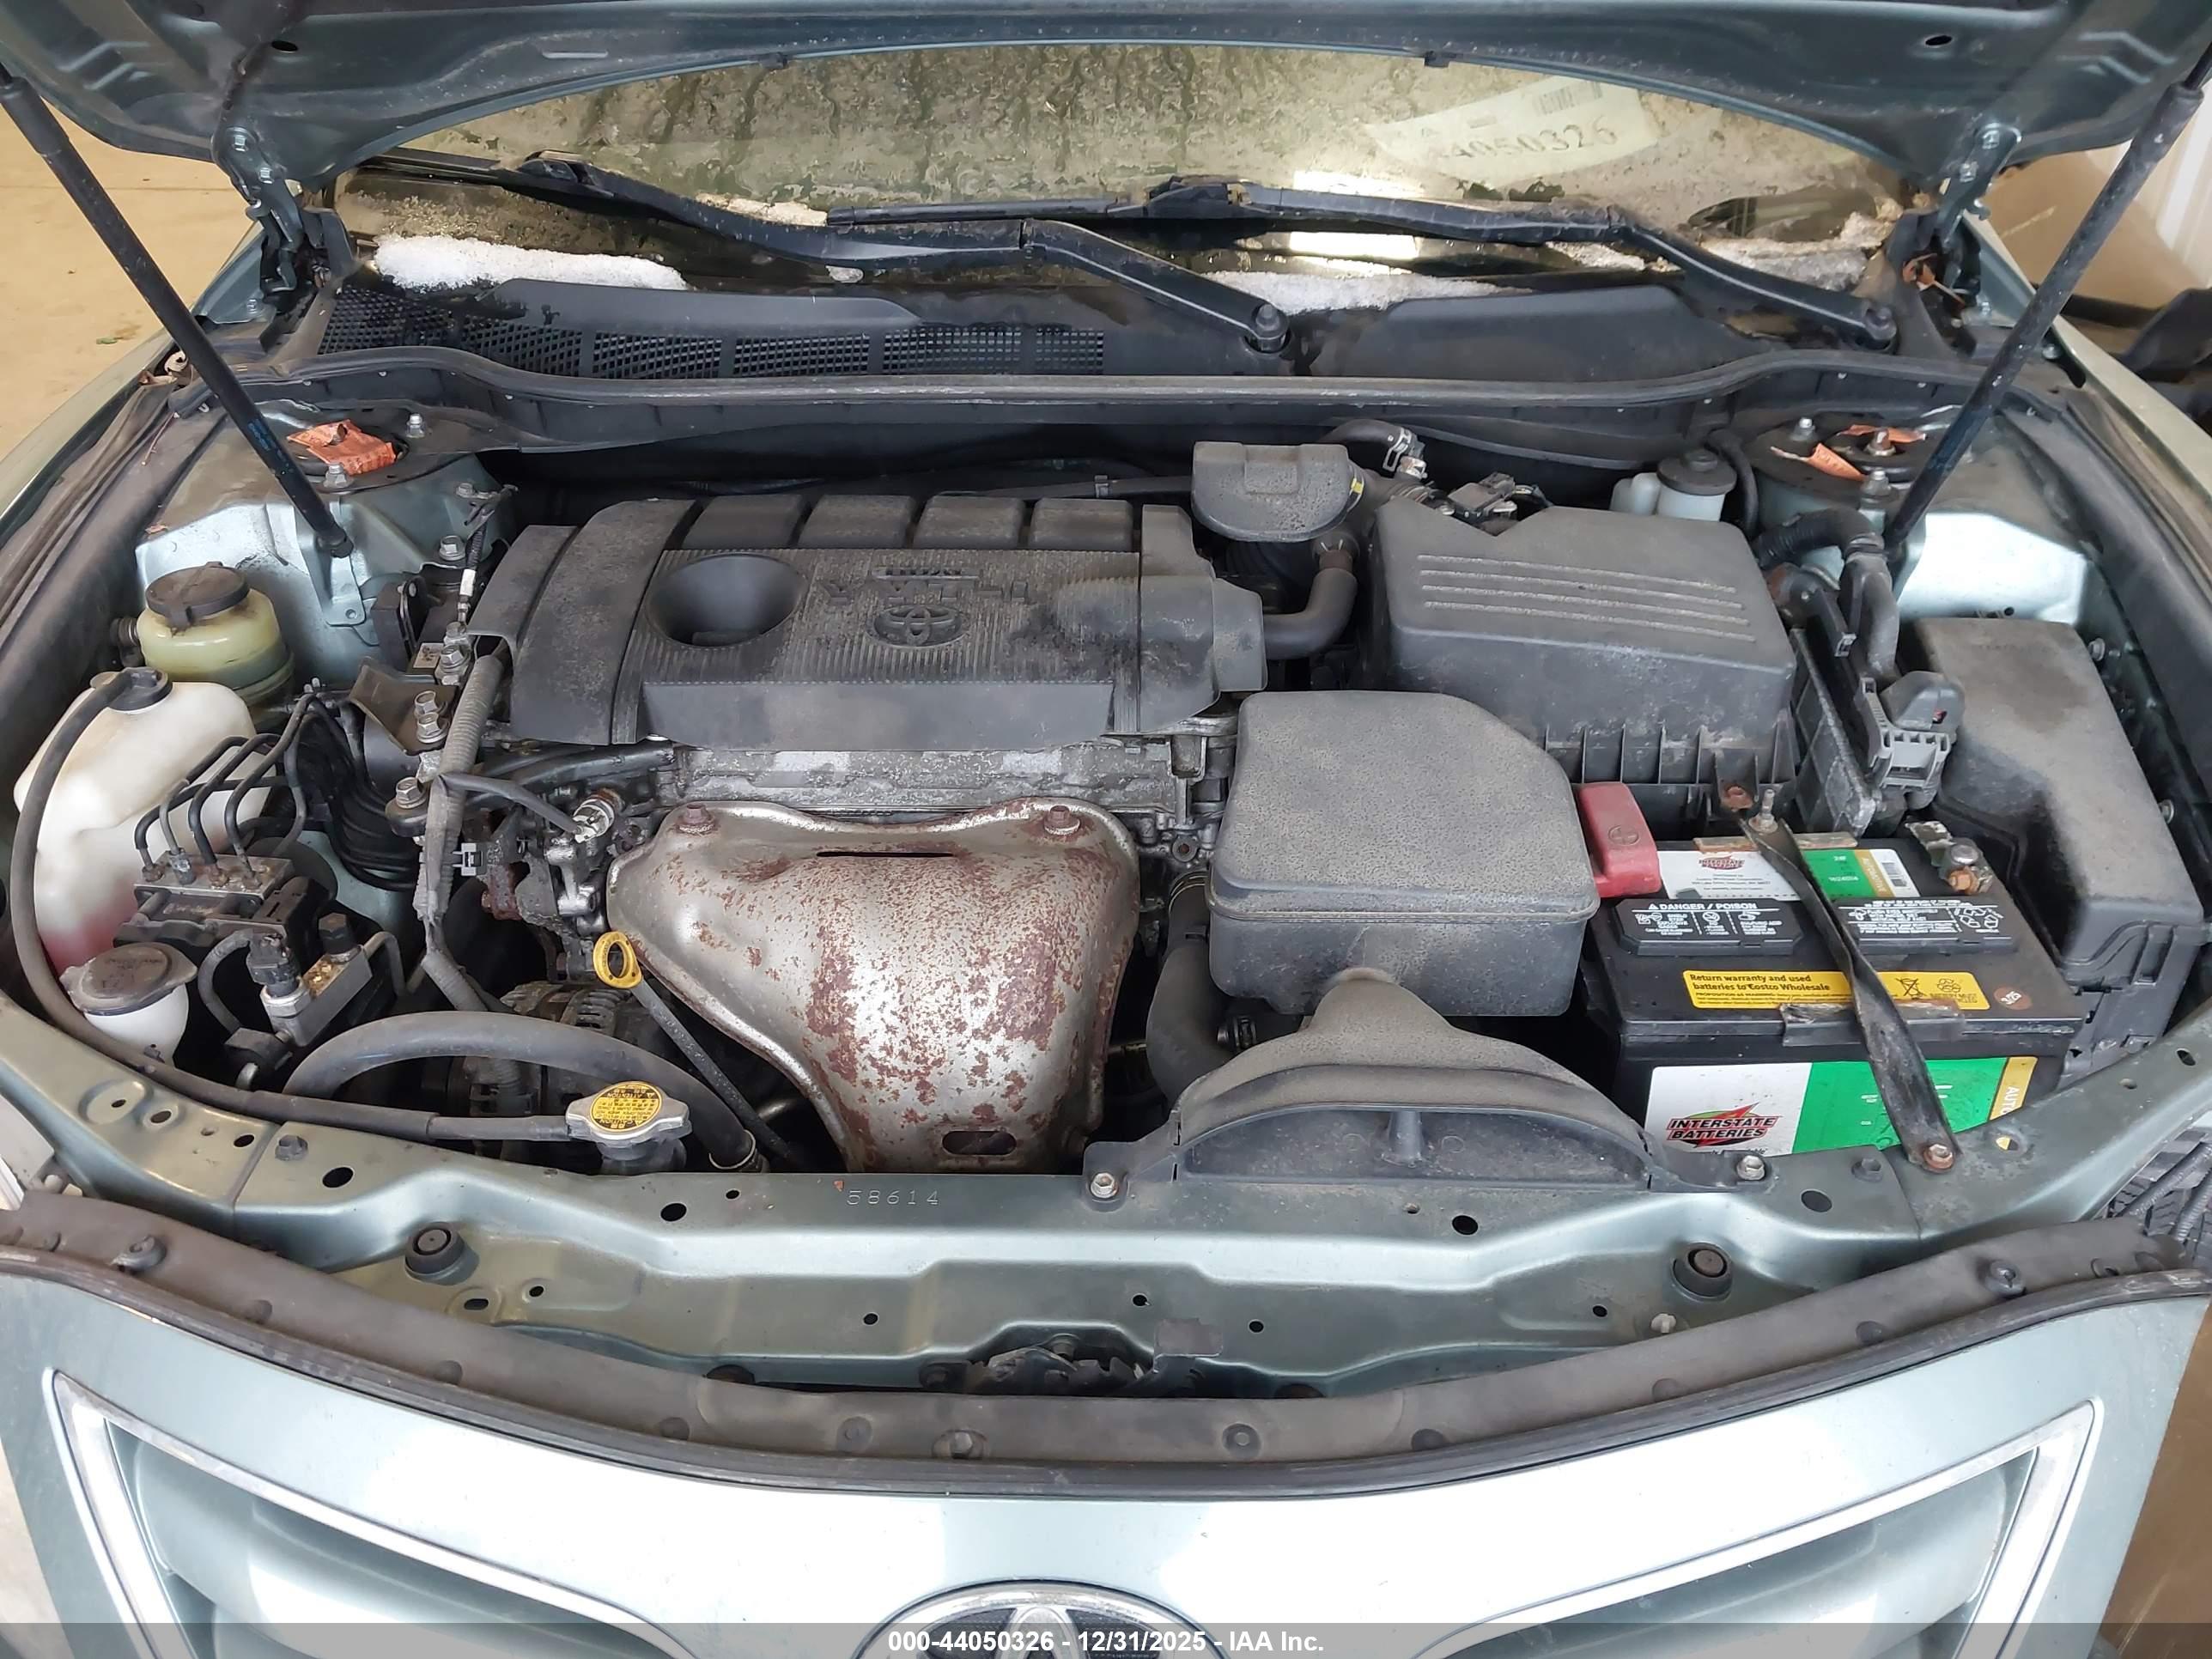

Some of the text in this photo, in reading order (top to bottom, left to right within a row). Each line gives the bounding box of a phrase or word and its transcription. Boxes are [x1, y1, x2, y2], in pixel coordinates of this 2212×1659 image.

[1725, 975, 1766, 983] warranty
[1670, 1117, 1774, 1128] INTERSTATE
[1672, 1128, 1765, 1139] BATTERIES
[847, 1190, 939, 1205] 58614
